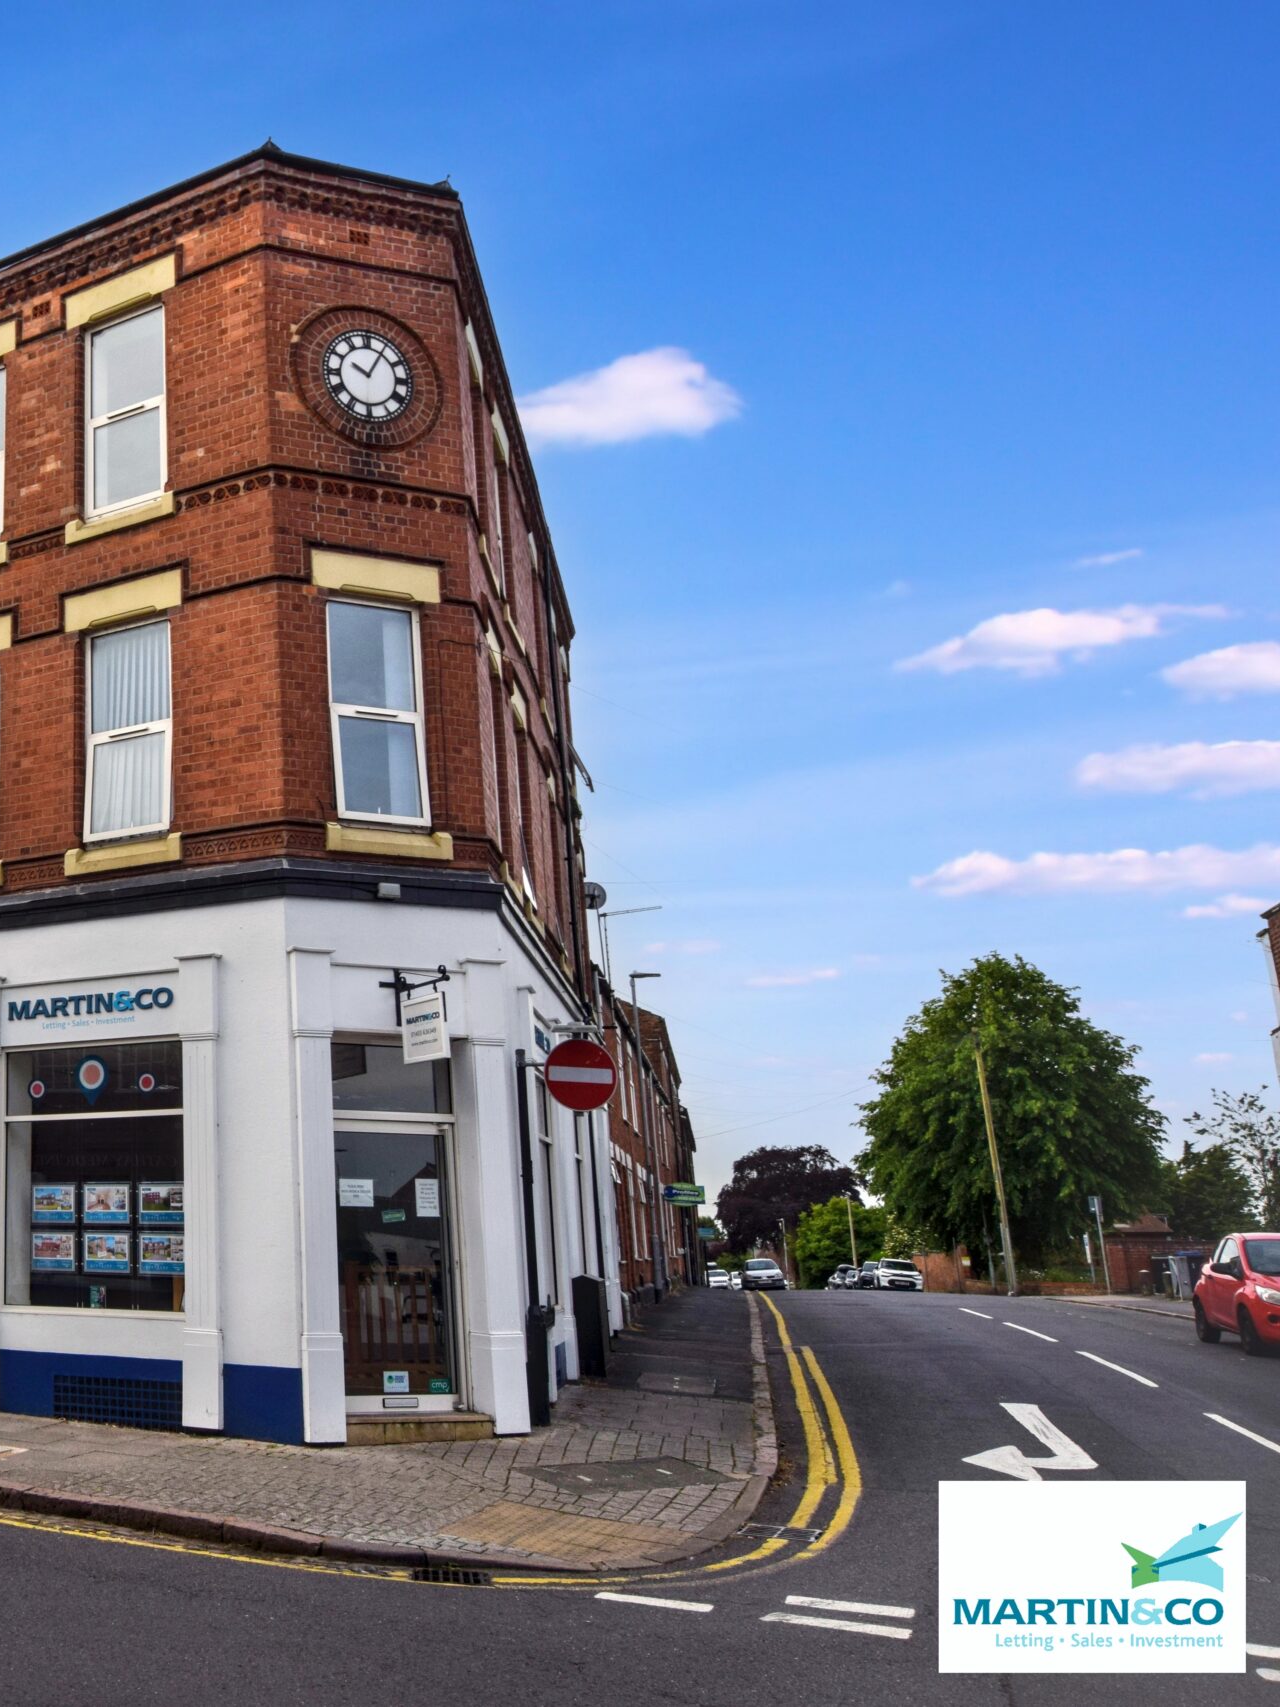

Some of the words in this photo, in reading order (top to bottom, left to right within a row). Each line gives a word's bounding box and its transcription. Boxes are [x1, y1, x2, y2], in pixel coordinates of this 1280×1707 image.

[7, 987, 174, 1021] MARTIN&CO
[41, 1021, 67, 1030] Letting
[71, 1019, 90, 1027] Sales
[95, 1016, 135, 1025] Investment
